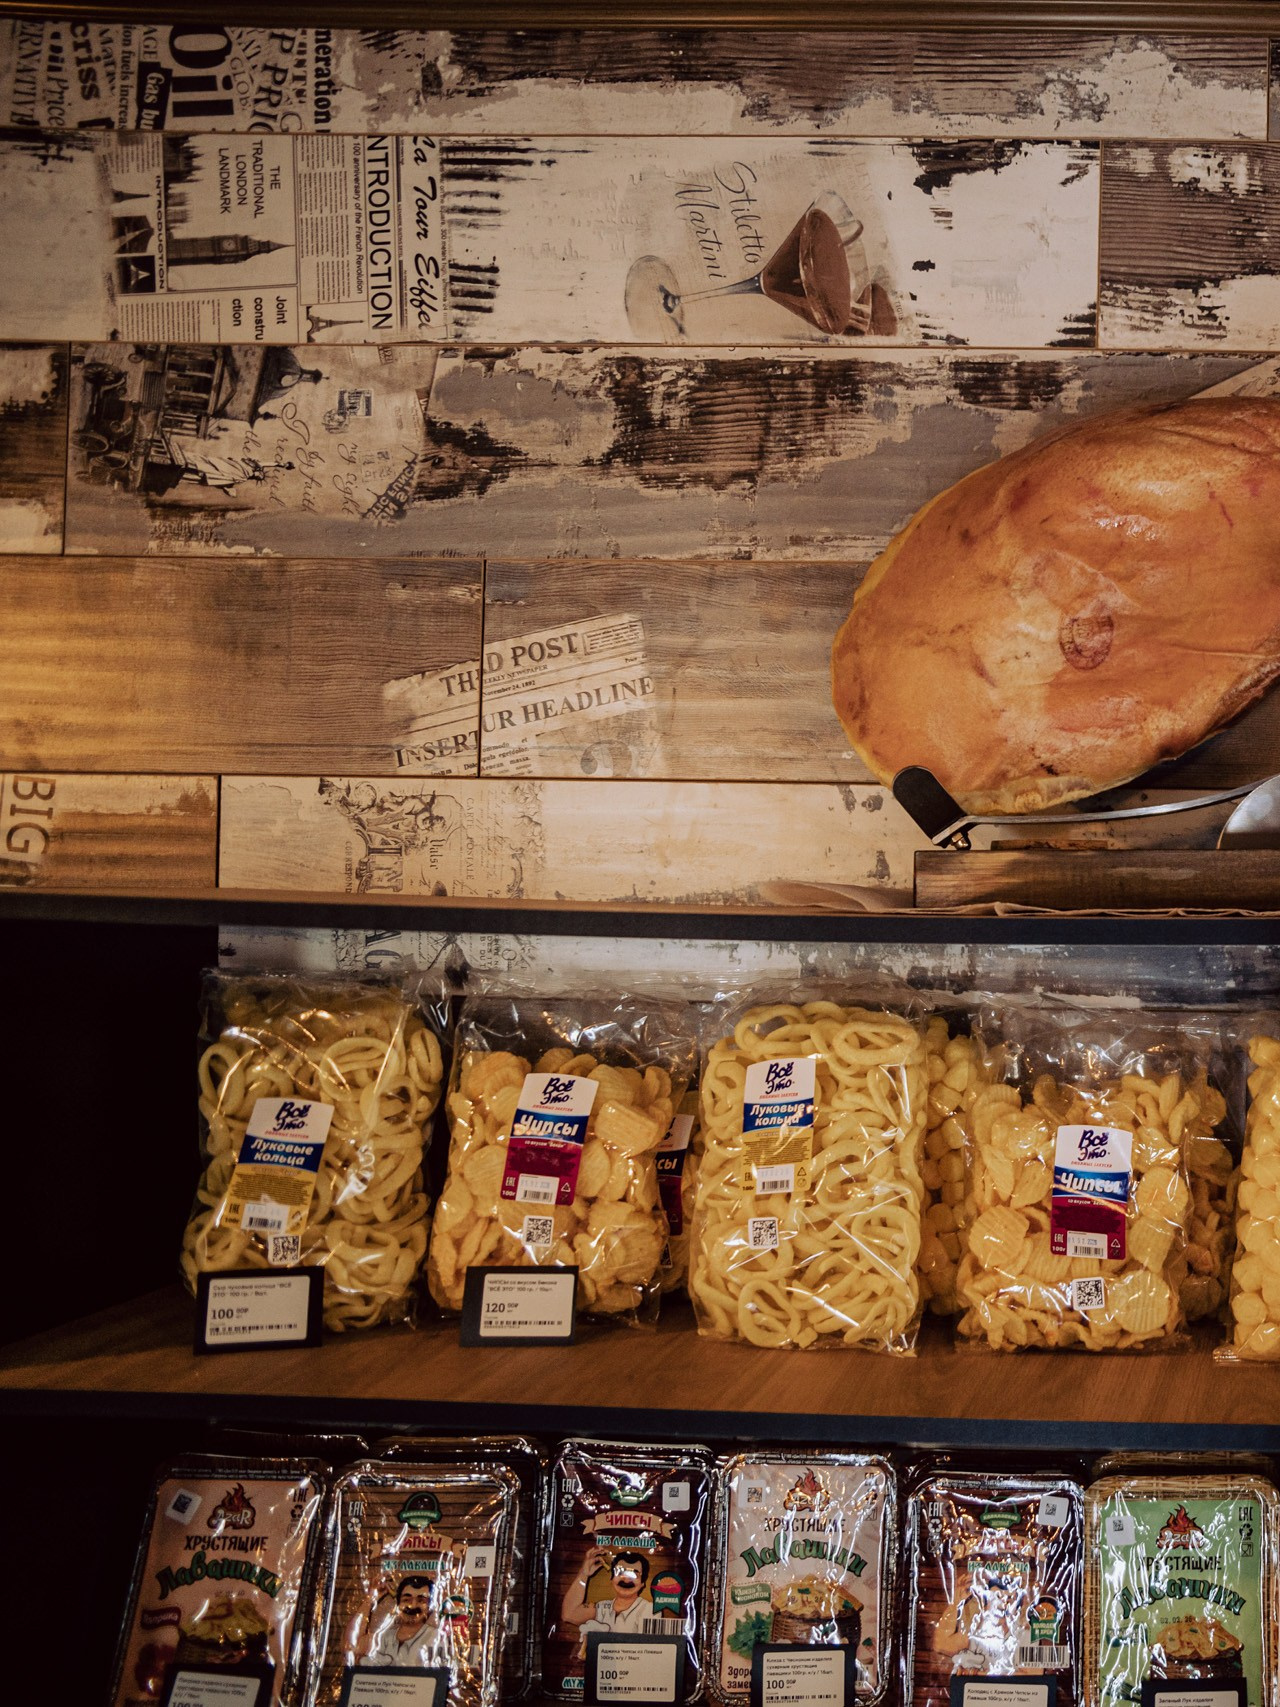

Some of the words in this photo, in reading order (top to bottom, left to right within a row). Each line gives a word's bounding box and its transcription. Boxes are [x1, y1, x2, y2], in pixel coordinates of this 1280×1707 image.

[70, 22, 101, 100] criss
[121, 51, 135, 81] fuels
[169, 24, 234, 118] Oil
[142, 71, 165, 104] Gas
[353, 143, 361, 156] 100
[219, 148, 231, 214] LANDMARK
[236, 155, 248, 205] LONDON
[253, 140, 264, 218] TRADITIONAL
[269, 166, 281, 190] THE
[353, 157, 361, 201] anniversary
[413, 176, 437, 240] Tour
[713, 162, 765, 264] Stiletto
[156, 175, 165, 289] INTRODUCTION
[355, 227, 363, 254] French
[674, 181, 726, 278] Martini
[356, 255, 365, 294] Revolution
[233, 299, 243, 327] ction
[254, 297, 264, 340] constru
[276, 296, 288, 324] Joint
[511, 633, 581, 668] POST
[522, 676, 656, 724] HEADLINE
[6, 775, 56, 854] BIG
[750, 1103, 806, 1117] Луковые
[755, 1115, 800, 1127] кольца
[250, 1139, 314, 1156] Луковые
[254, 1152, 305, 1166] кольца
[212, 1309, 234, 1320] 100
[486, 1303, 506, 1313] 120
[605, 1513, 652, 1527] ЧИПСЫ
[764, 1517, 846, 1533] ХРУСТЯЩИЕ
[184, 1535, 269, 1553] ХРУСТЯЩИЕ
[597, 1535, 612, 1546] ИЗ
[613, 1537, 657, 1548] ЛАВАША
[600, 1671, 617, 1680] 100
[766, 1680, 784, 1689] 100
